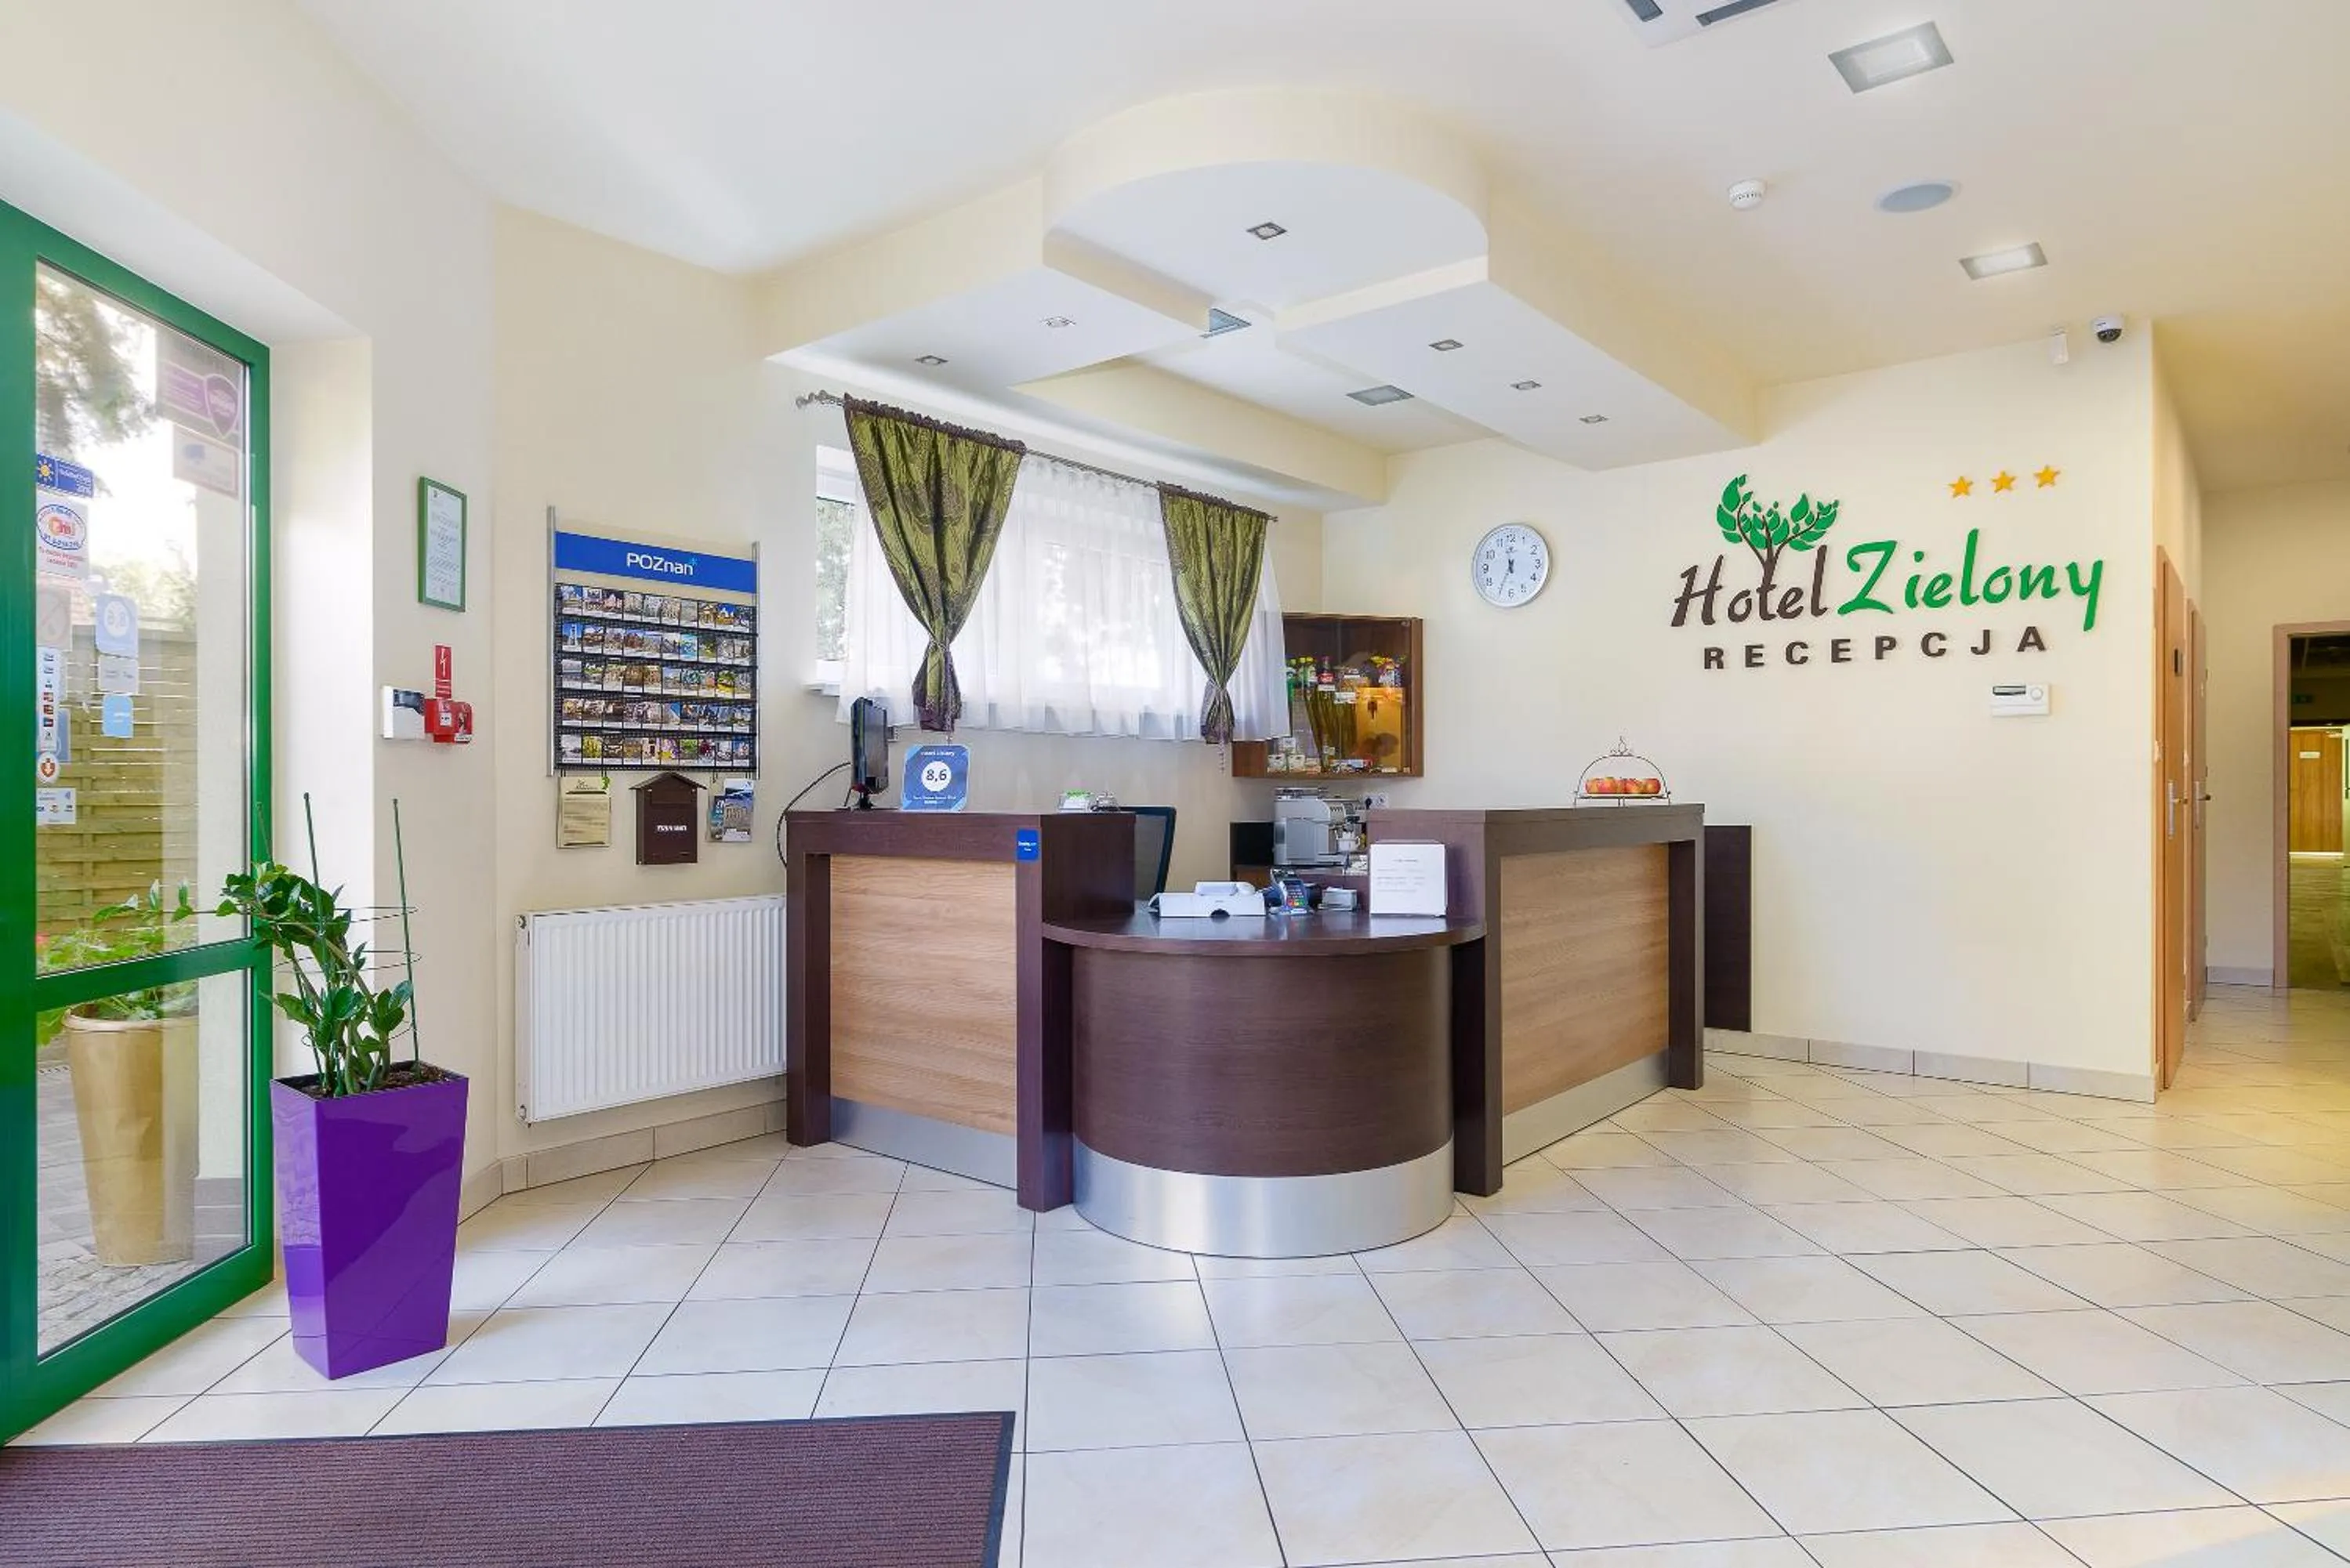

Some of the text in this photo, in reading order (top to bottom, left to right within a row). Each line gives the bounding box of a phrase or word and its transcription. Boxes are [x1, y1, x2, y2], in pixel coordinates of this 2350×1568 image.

[1485, 549, 1496, 560] 10
[1529, 545, 1538, 556] 2
[1481, 563, 1489, 574] 9
[1534, 558, 1541, 570] 3
[1529, 573, 1537, 581] 4
[1670, 527, 2105, 632] Hotel Zielony
[1703, 625, 2047, 670] RECEPCJA
[926, 768, 948, 783] 8,6
